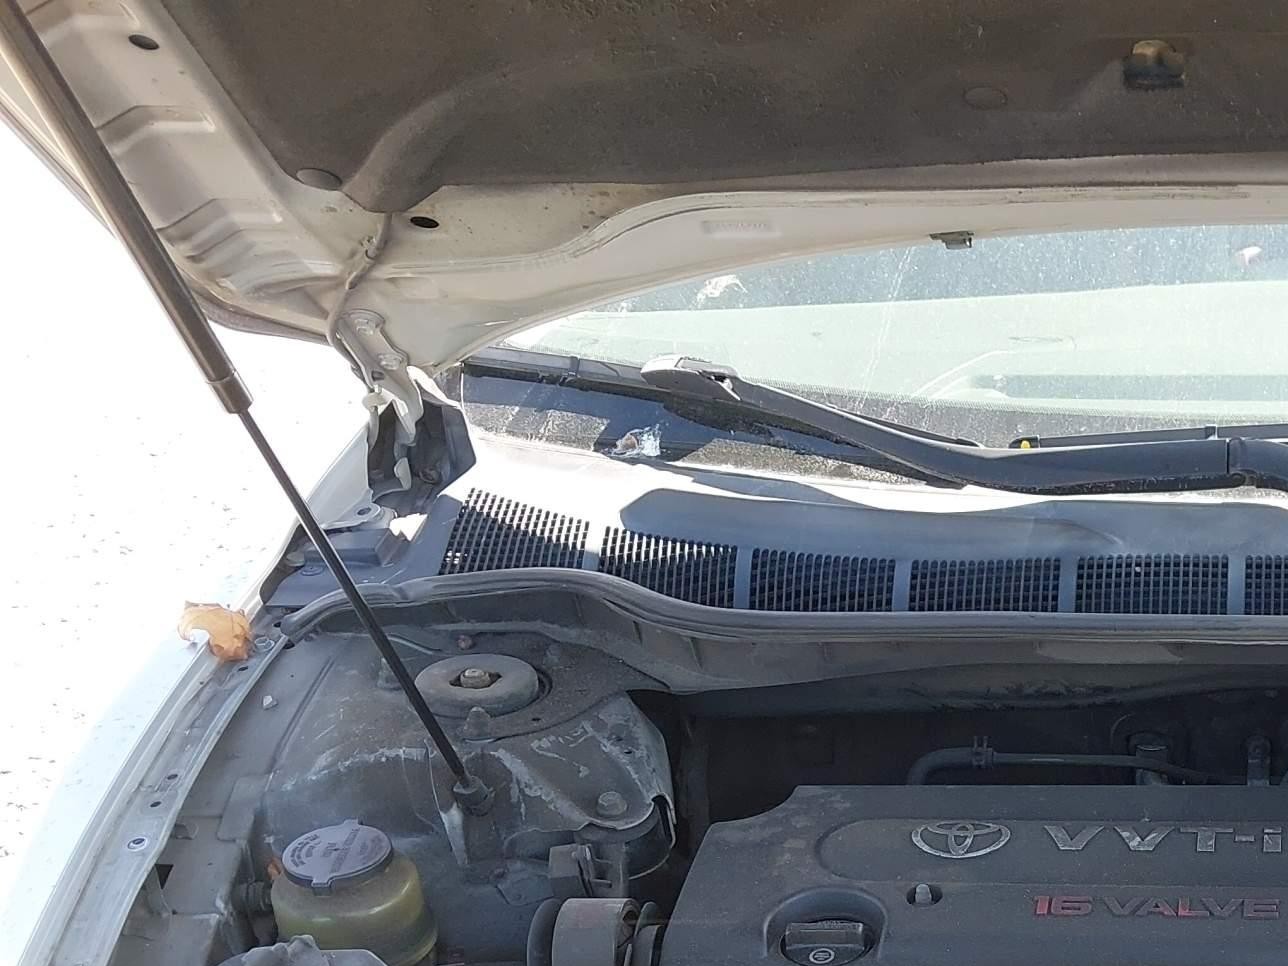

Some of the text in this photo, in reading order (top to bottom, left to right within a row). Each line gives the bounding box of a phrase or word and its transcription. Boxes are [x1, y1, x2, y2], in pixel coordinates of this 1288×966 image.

[1043, 825, 1282, 853] VVT-i
[1034, 895, 1281, 920] 16 VALVE
